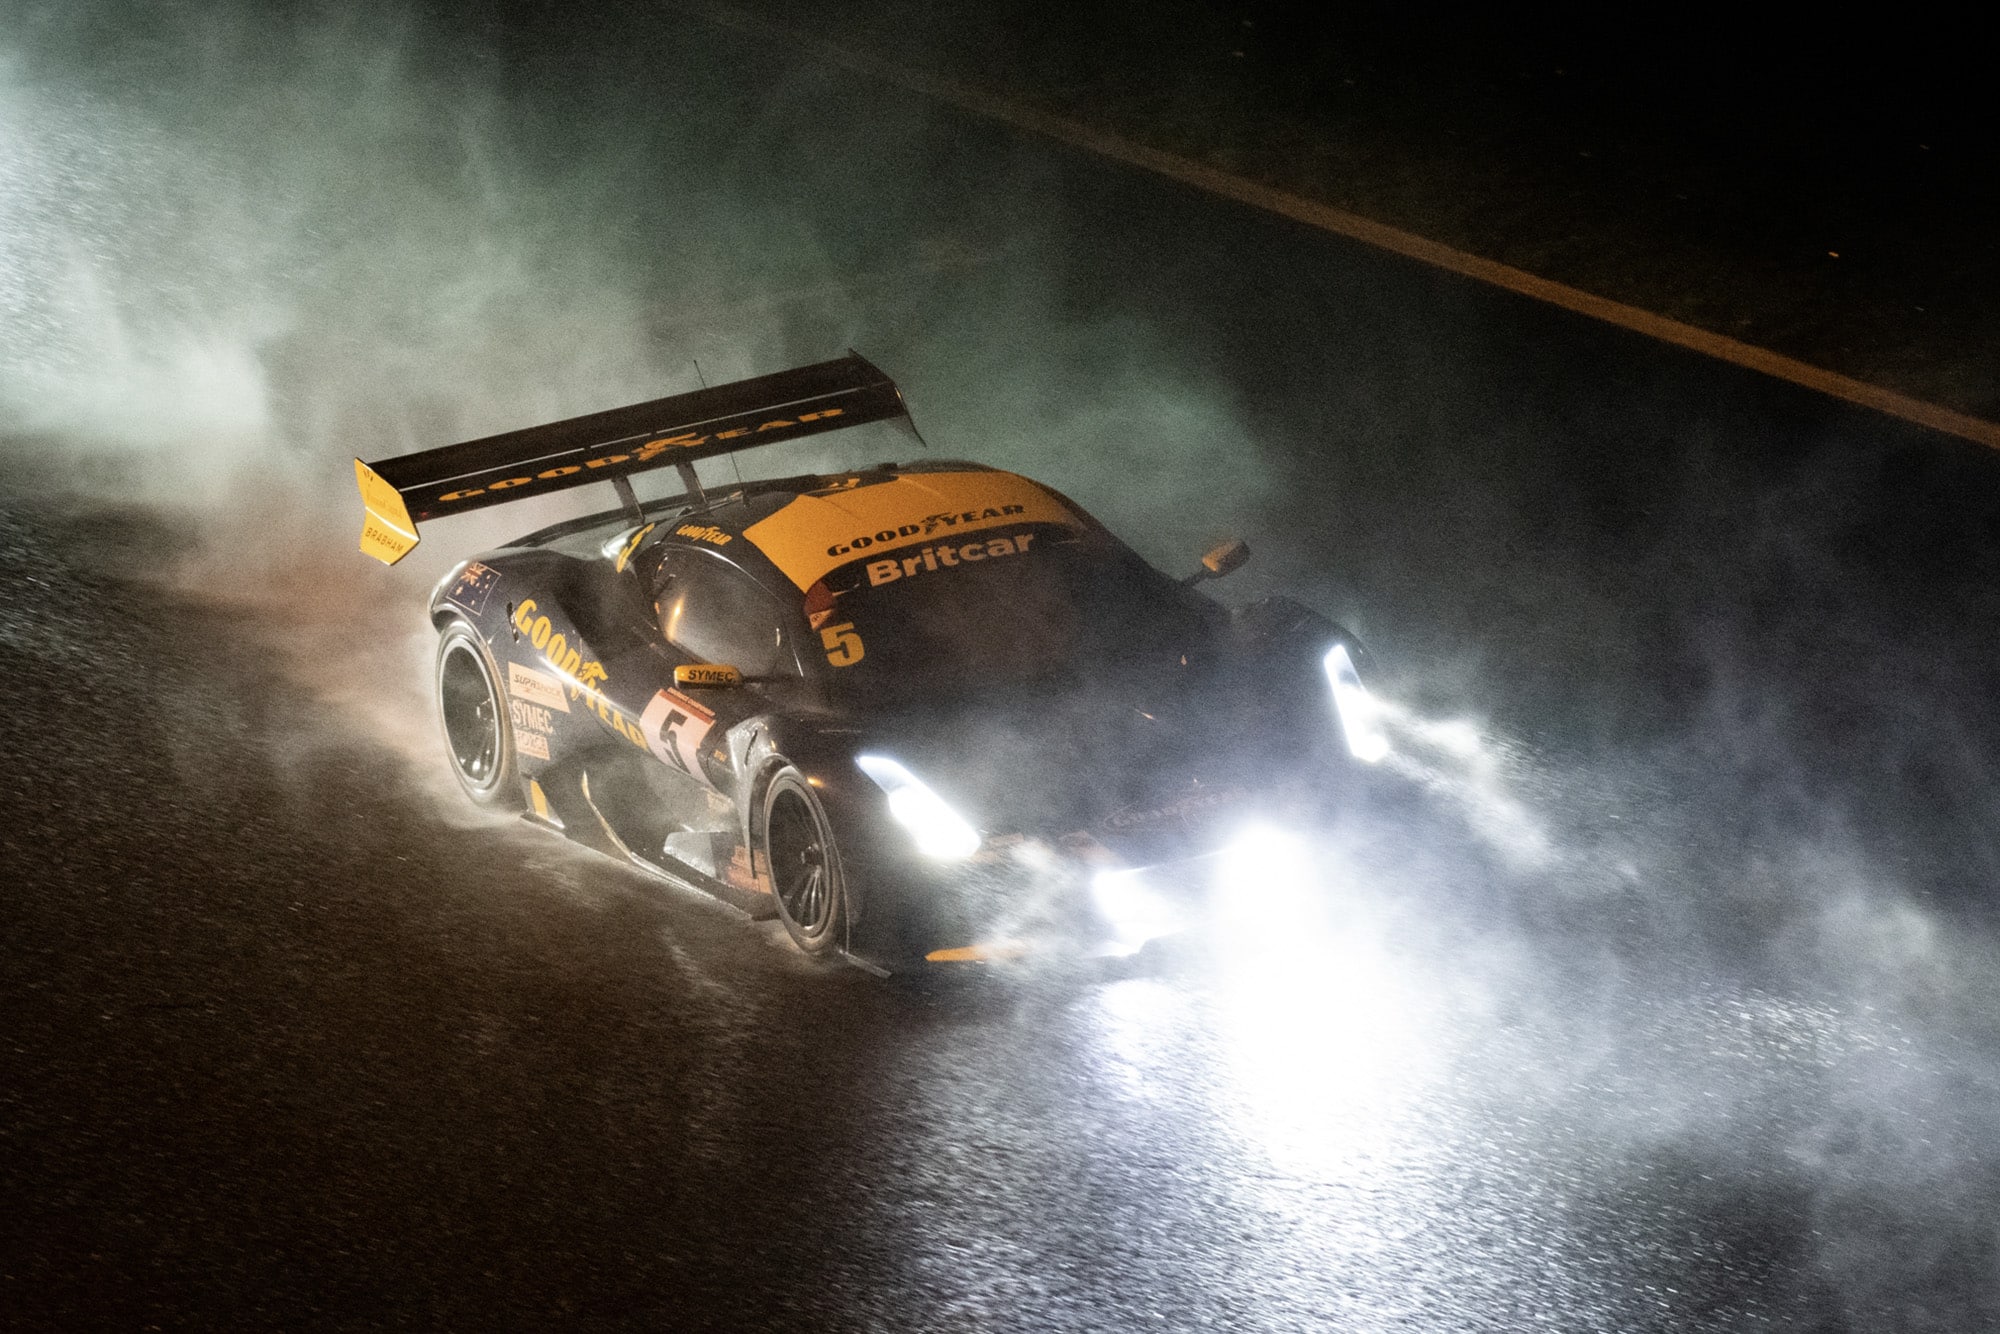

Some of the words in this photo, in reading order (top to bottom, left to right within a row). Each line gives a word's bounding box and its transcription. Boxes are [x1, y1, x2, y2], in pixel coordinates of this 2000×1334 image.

[438, 407, 844, 501] GOODYEAR
[365, 526, 402, 553] BRABHAM
[826, 504, 1024, 557] GOODYEAR
[865, 532, 1034, 587] Britcar
[820, 621, 865, 668] 5
[688, 669, 734, 683] SYMEC
[512, 701, 553, 733] SYMEC
[659, 709, 692, 775] 5
